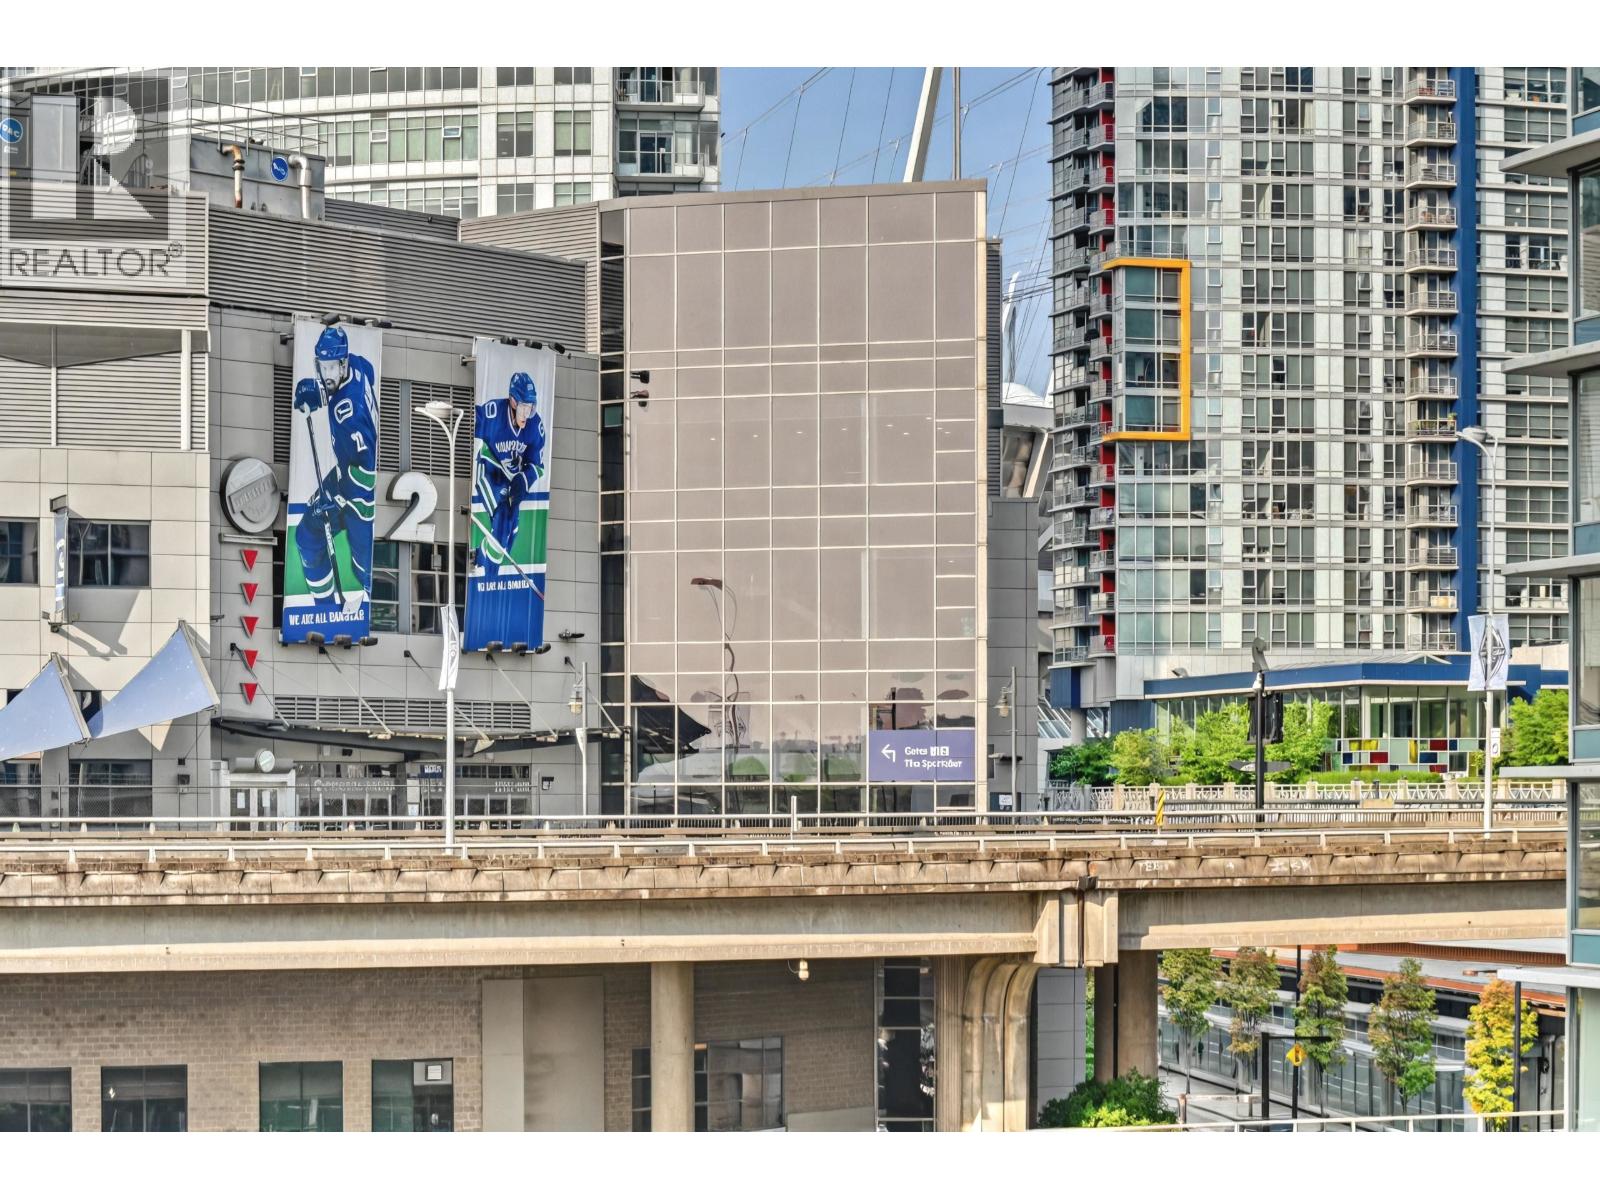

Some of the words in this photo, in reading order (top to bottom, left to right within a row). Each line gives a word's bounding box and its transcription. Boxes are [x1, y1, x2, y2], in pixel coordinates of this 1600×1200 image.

[386, 472, 437, 543] 2
[289, 614, 300, 626] WE
[301, 613, 314, 625] ARE
[315, 612, 328, 624] ALL
